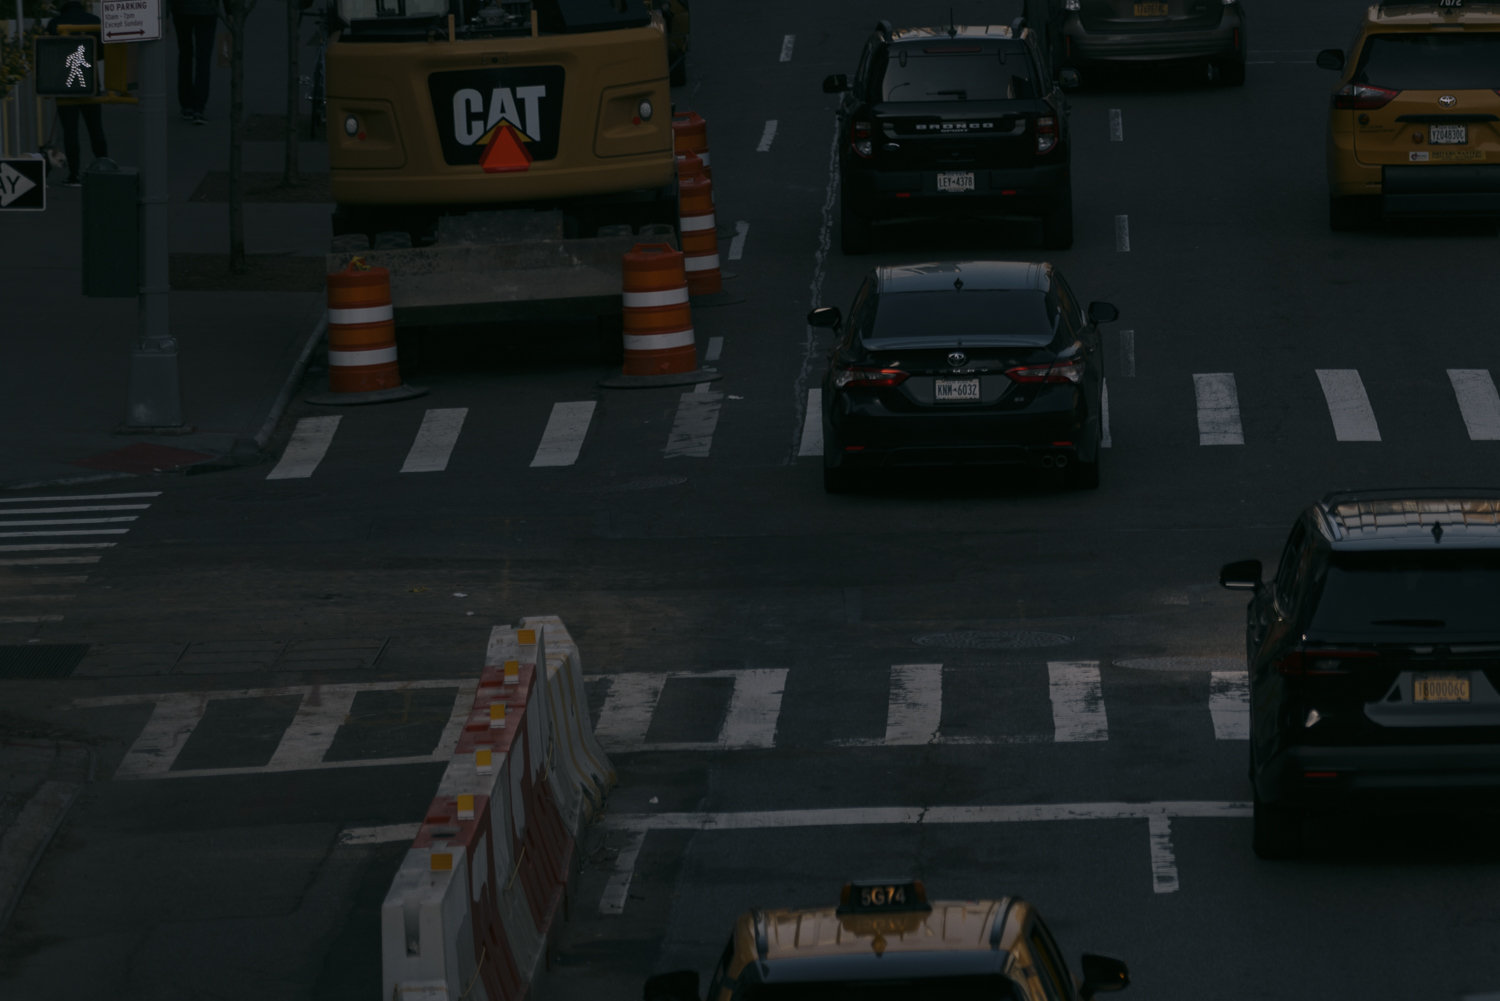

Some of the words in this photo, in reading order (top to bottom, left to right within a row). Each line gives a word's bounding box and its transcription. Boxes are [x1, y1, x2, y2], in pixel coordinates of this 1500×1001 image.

[105, 4, 115, 12] NO
[117, 1, 147, 11] PARKING
[105, 13, 119, 21] 10am
[105, 21, 123, 29] Except
[125, 20, 144, 28] Sunday
[453, 85, 546, 146] CAT
[916, 122, 994, 130] BRONCO
[861, 886, 906, 906] 5G74
